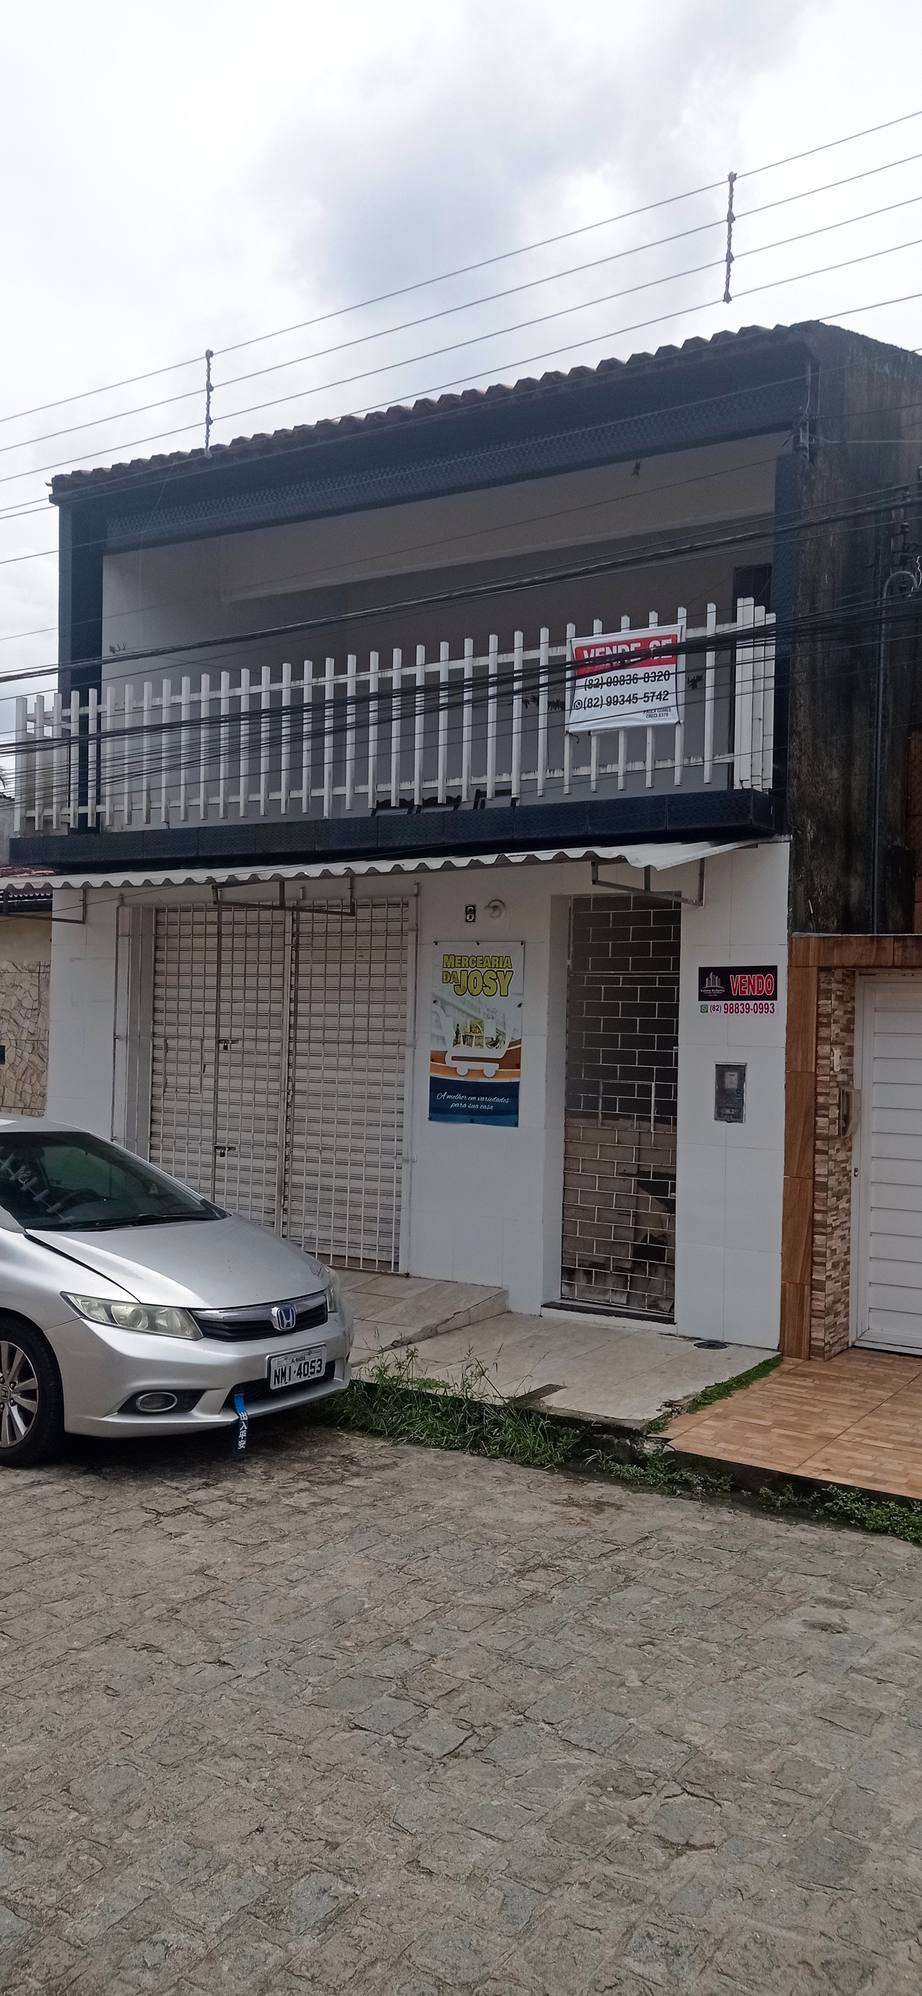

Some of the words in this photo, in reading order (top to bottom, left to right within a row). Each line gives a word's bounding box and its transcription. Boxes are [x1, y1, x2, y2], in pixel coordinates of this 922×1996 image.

[584, 695, 604, 710] (82)
[443, 954, 512, 968] MERCEARIA
[442, 971, 459, 984] DA
[454, 969, 514, 997] JOSY
[729, 974, 774, 996] VENDO
[710, 1004, 721, 1013] (82)
